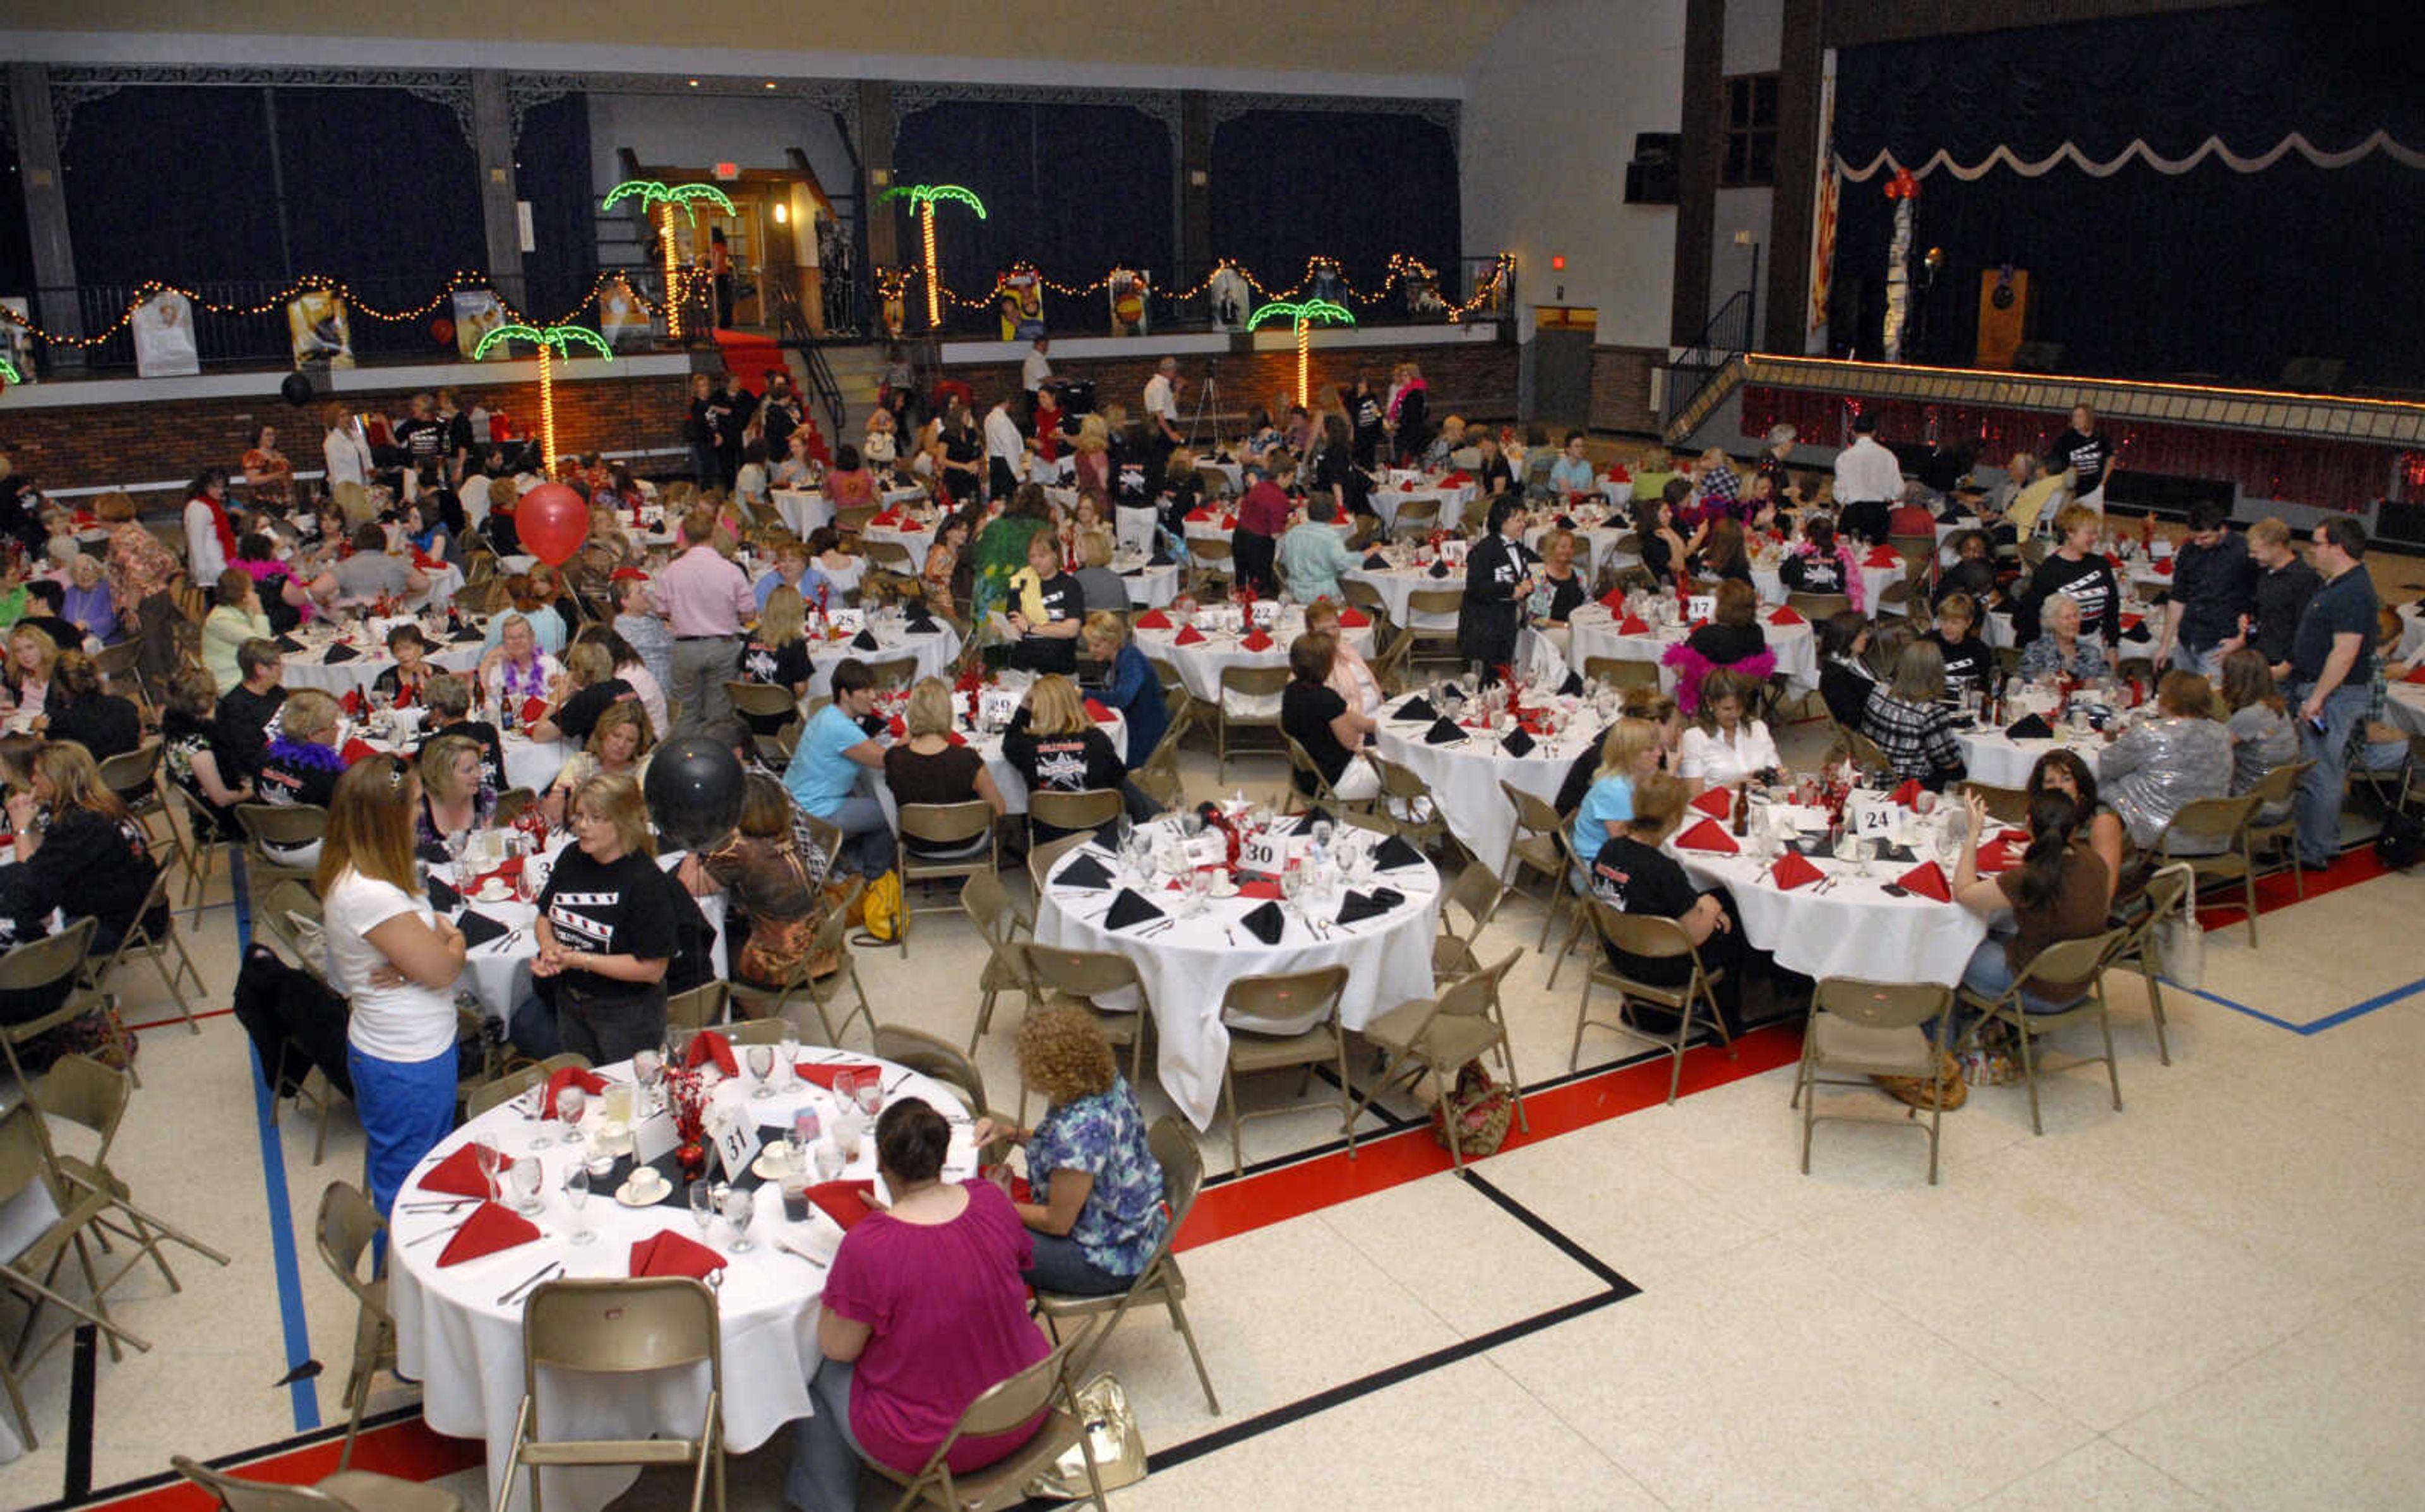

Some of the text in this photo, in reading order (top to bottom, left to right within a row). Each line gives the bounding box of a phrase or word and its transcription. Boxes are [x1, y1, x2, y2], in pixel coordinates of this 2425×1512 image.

[1694, 602, 1709, 613] 17
[1865, 811, 1889, 828] 24
[1246, 843, 1272, 863] 30
[728, 1126, 746, 1162] 31
